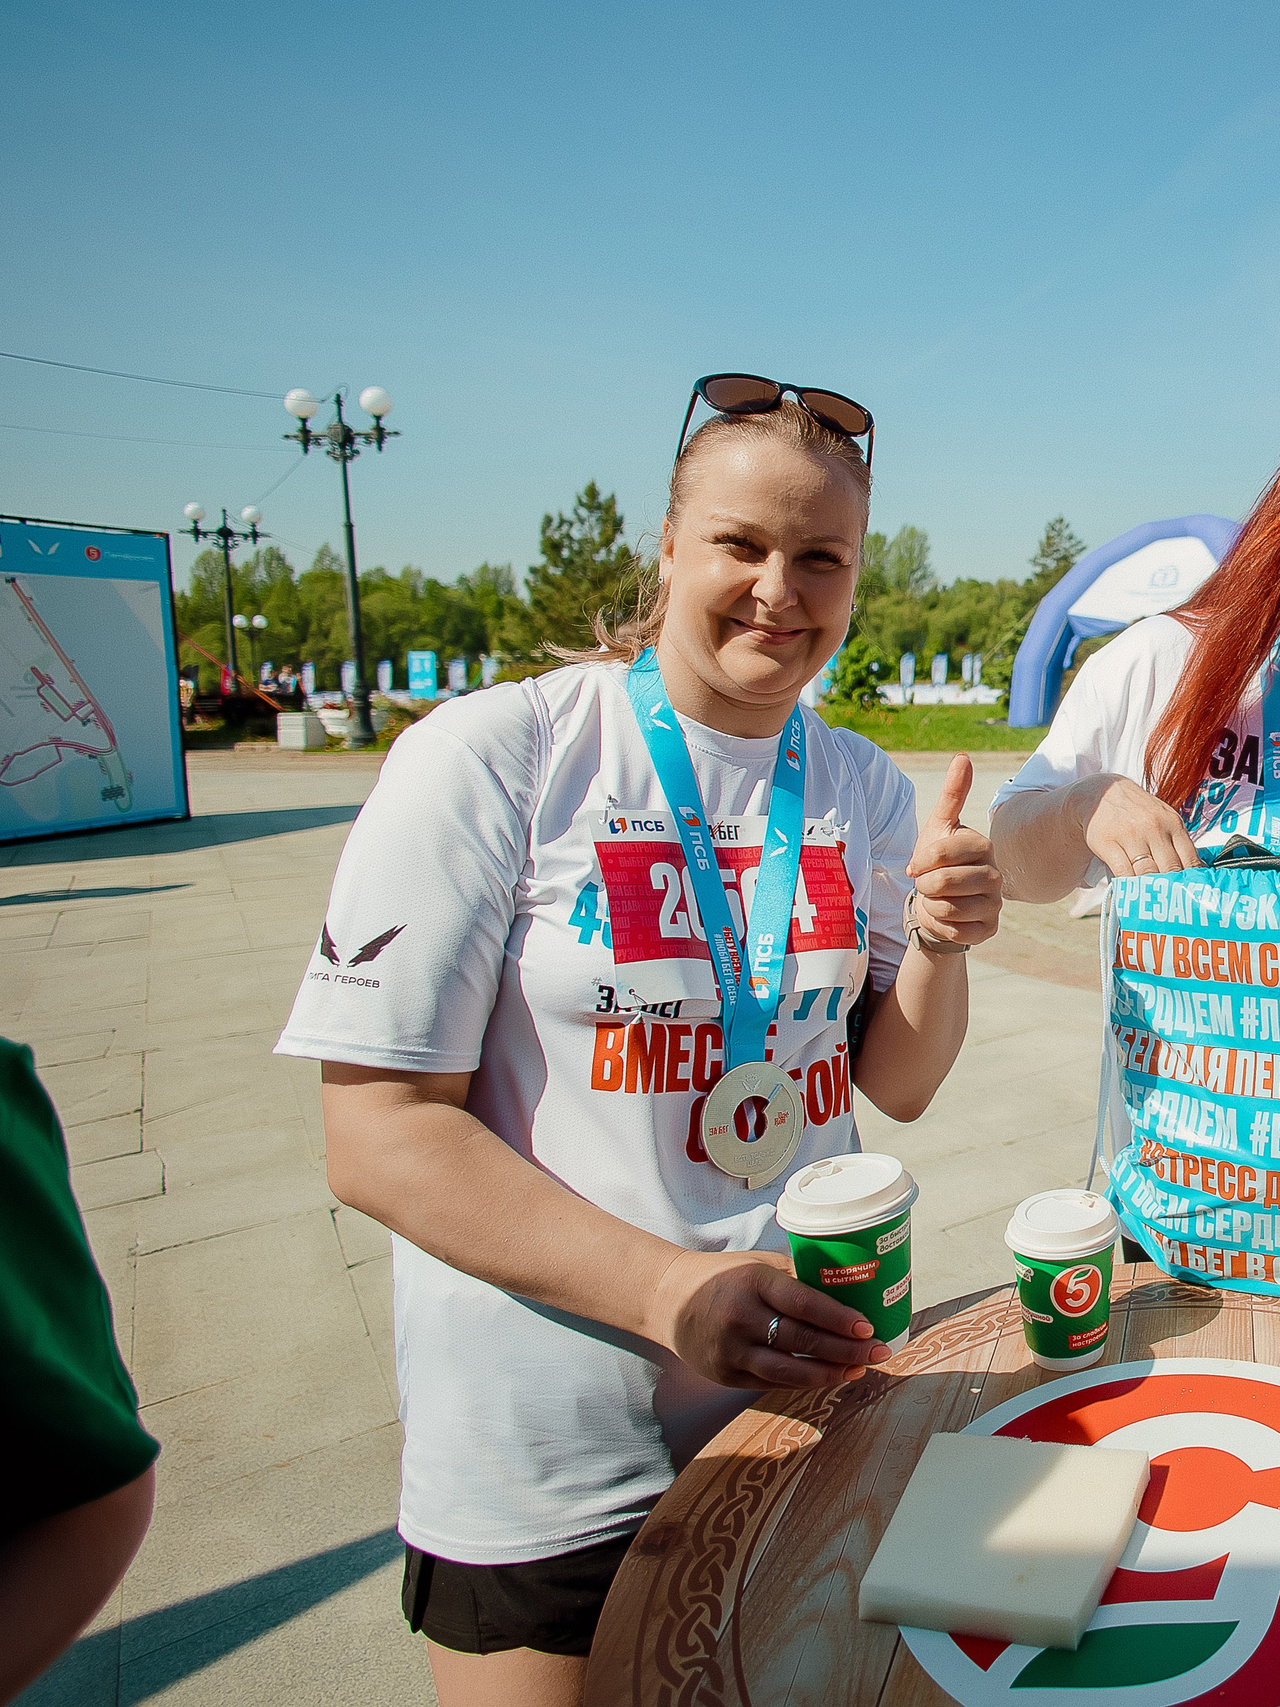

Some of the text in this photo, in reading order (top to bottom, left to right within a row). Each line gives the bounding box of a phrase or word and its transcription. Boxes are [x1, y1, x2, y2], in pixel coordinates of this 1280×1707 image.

[790, 718, 801, 750] ПСБ
[631, 820, 665, 832] ПСБ
[689, 831, 711, 871] ПСБ
[754, 933, 774, 972] ПСБ
[1173, 936, 1252, 984] ВСЕМ
[334, 974, 381, 988] ГЕРОЕВ
[722, 962, 732, 976] БЕГ
[823, 1261, 876, 1276] За горячим
[832, 1272, 869, 1283] сытным
[1187, 1244, 1239, 1277] БЕГ
[1247, 1252, 1266, 1280] В
[1065, 1267, 1094, 1308] 5
